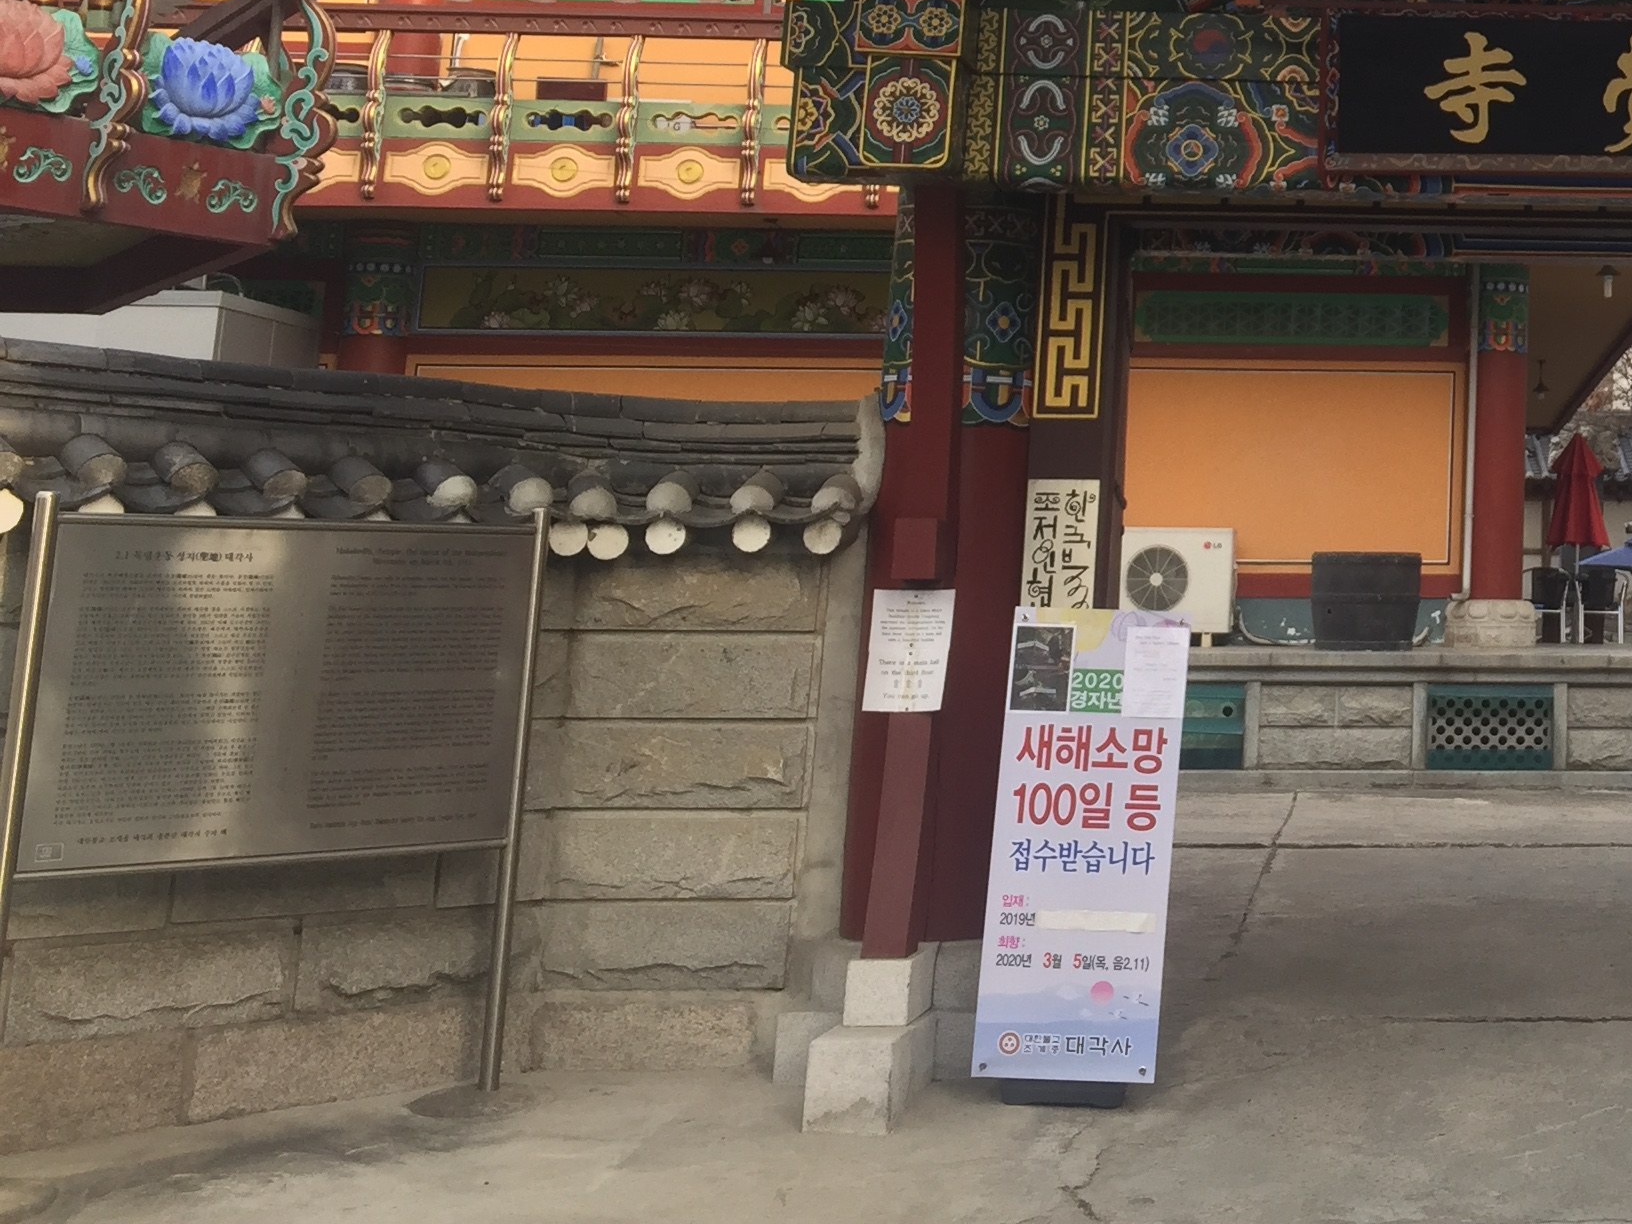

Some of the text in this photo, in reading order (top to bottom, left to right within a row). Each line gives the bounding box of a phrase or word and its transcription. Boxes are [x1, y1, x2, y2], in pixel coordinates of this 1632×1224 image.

[1072, 672, 1124, 689] 2020
[1016, 724, 1168, 774] 새해소망
[1013, 782, 1161, 832] 100일 등
[1009, 838, 1155, 875] 접수받습니다
[1000, 912, 1036, 926] 2019년
[996, 953, 1032, 968] 2020년
[1043, 952, 1062, 969] 3월
[1066, 1036, 1132, 1056] 대각사
